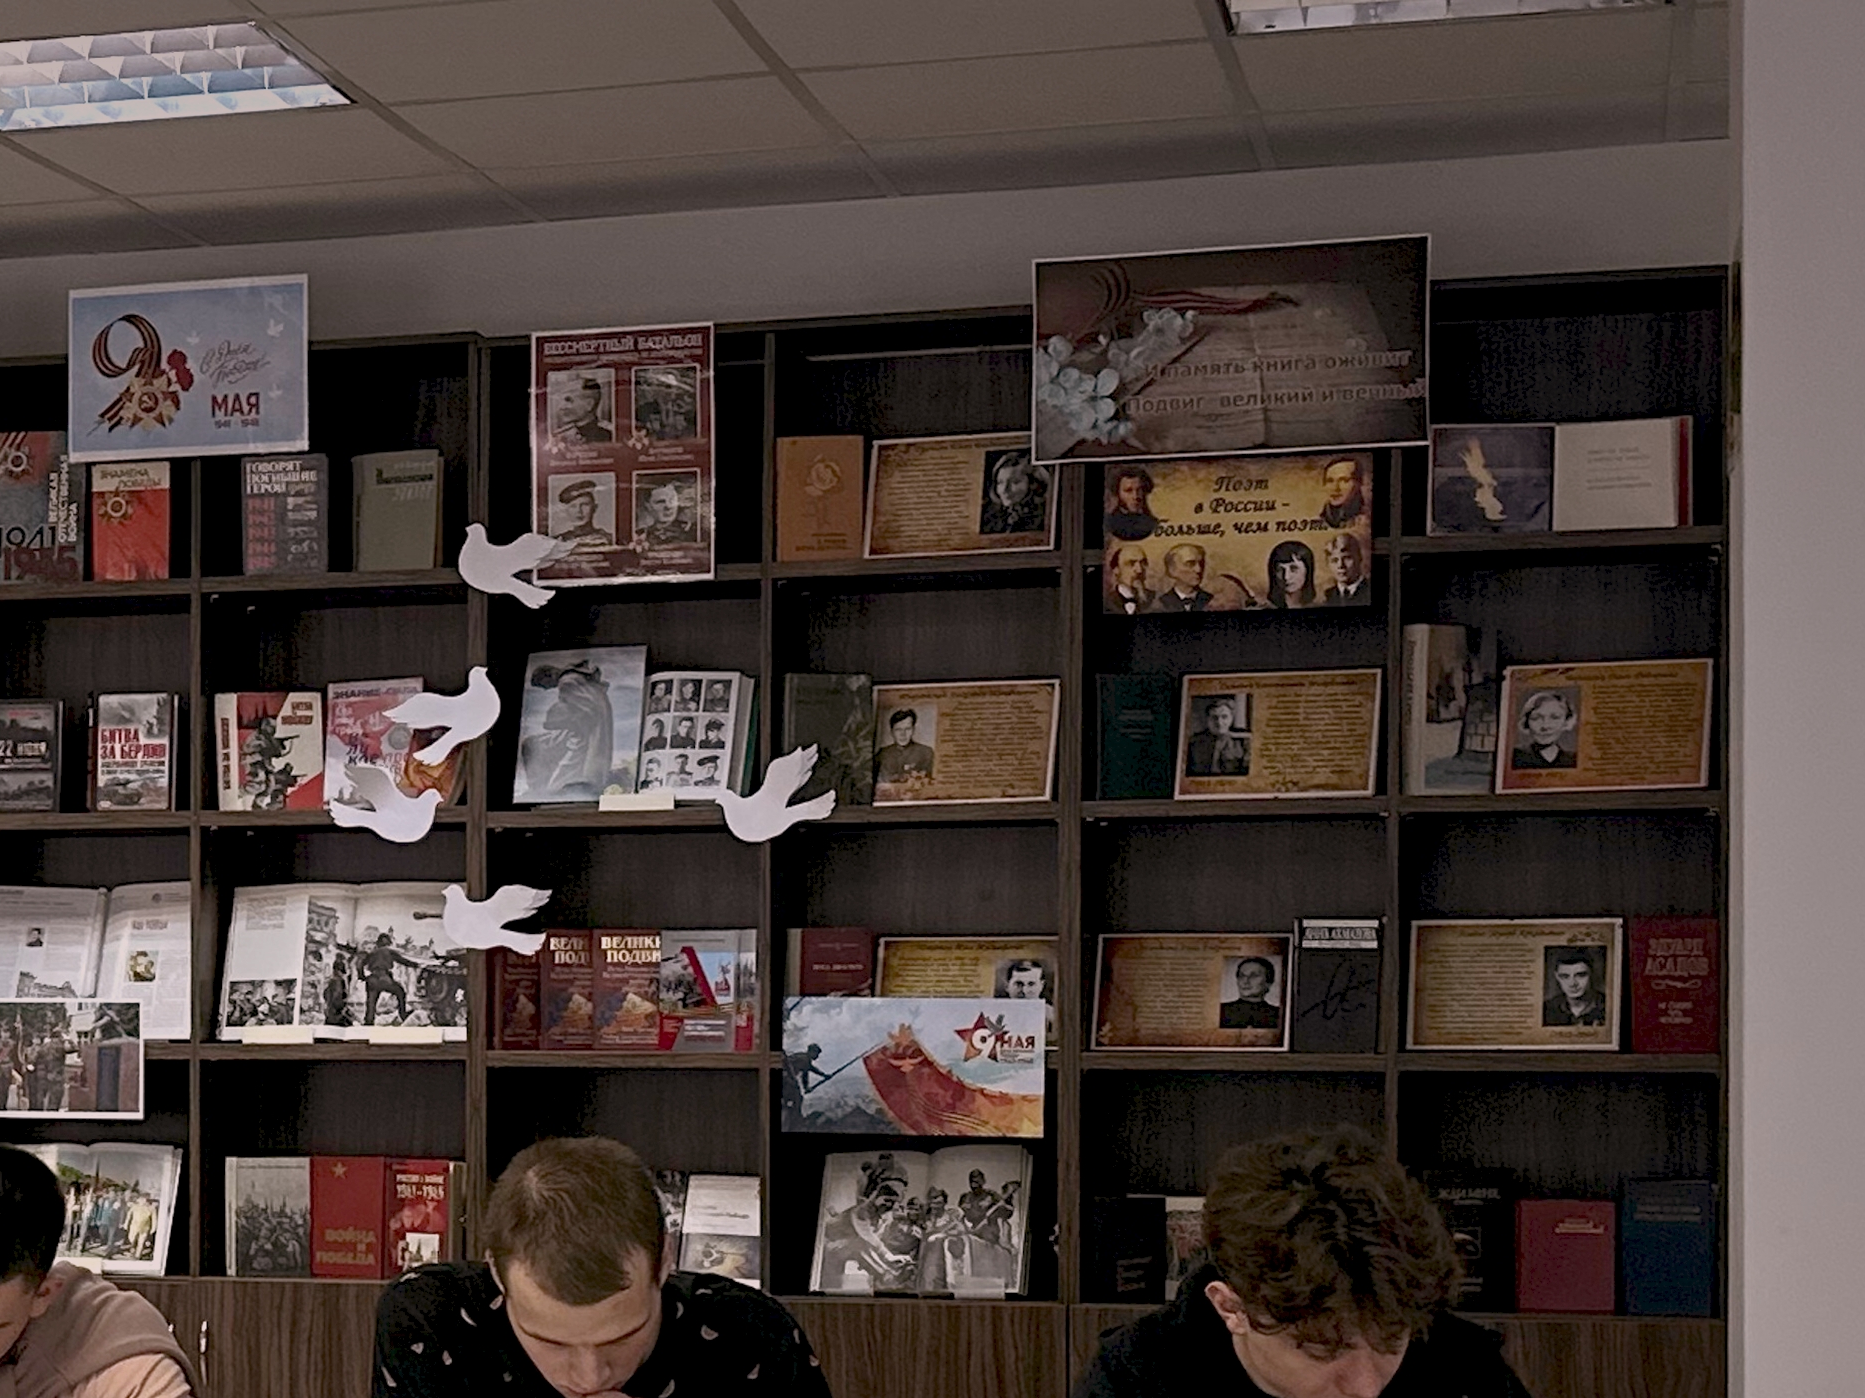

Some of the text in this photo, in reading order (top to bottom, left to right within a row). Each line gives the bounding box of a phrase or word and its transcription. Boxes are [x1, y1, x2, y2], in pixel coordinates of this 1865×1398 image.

[1163, 360, 1247, 381] память
[1252, 355, 1317, 374] книга
[211, 392, 260, 418] МАЯ
[1124, 396, 1204, 418] Подвиг
[1219, 386, 1314, 409] великий
[1213, 476, 1270, 493] Поэт
[1194, 502, 1204, 514] в
[1209, 497, 1277, 514] России
[1154, 519, 1225, 538] больше,
[1233, 522, 1270, 535] чем
[100, 727, 141, 744] БИТВА
[100, 744, 116, 760] ЗА
